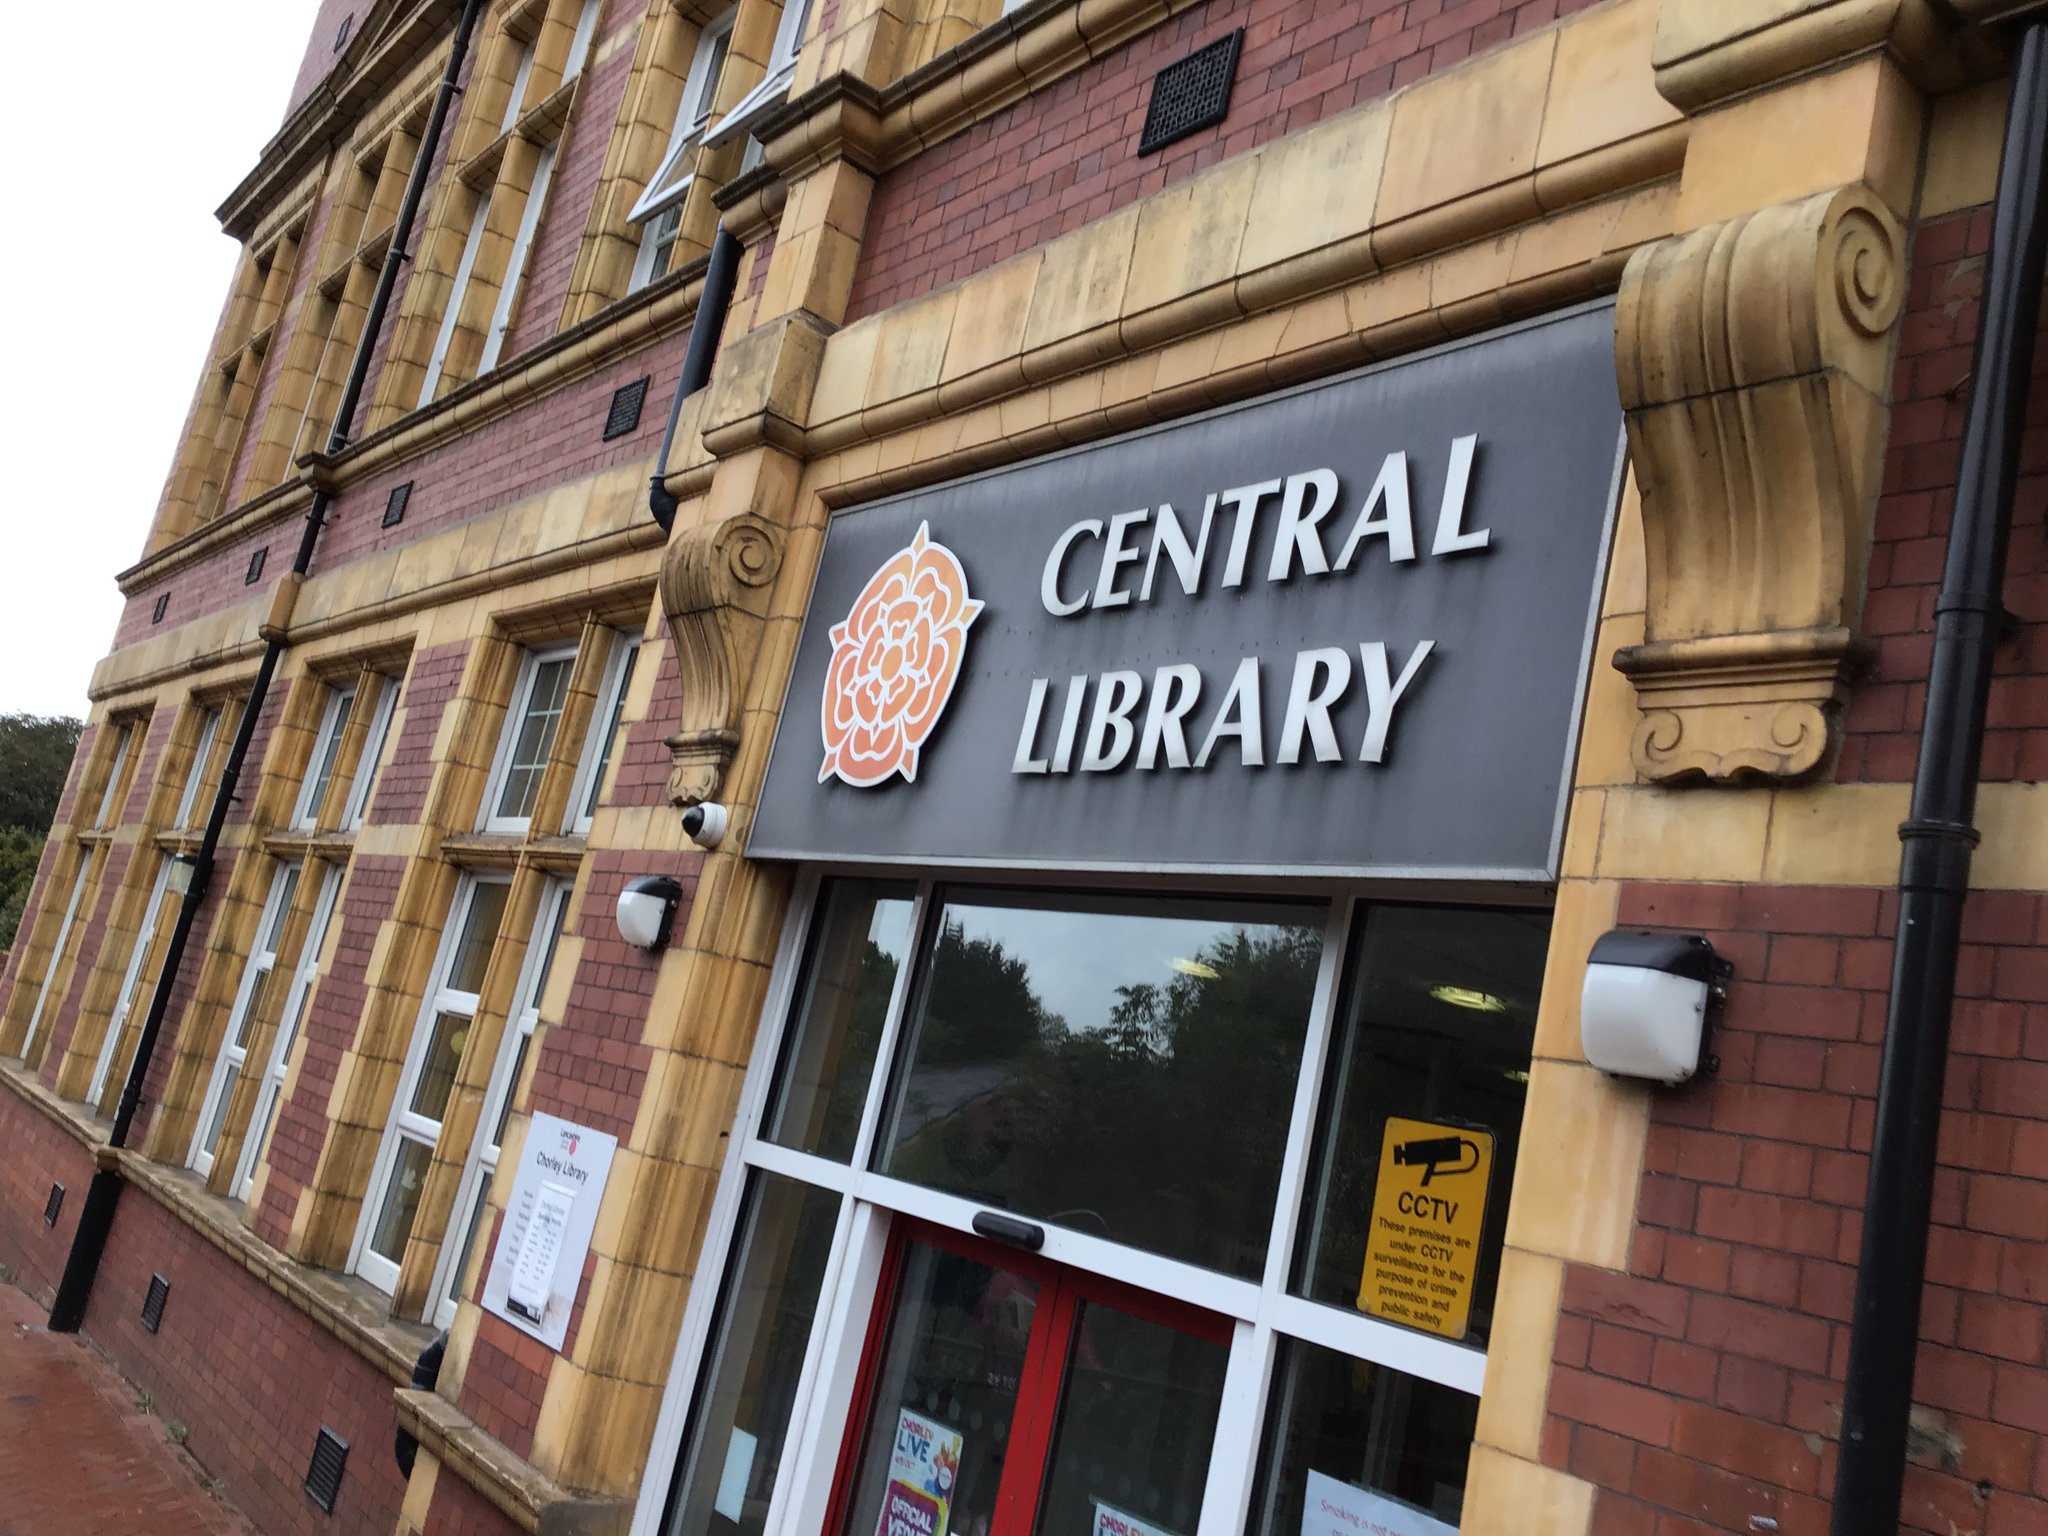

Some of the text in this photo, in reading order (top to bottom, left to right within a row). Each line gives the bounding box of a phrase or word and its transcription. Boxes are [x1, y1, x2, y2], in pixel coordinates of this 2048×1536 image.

[1040, 433, 1491, 616] CENTRAL
[1010, 639, 1437, 774] LIBRARY
[536, 1151, 589, 1186] Chorley Library
[1398, 1191, 1458, 1224] CCTV
[1379, 1216, 1471, 1248] These premises are
[1389, 1239, 1453, 1262] under CCTV
[1373, 1252, 1465, 1283] surveillance for the
[1376, 1268, 1456, 1297] purpose of crime
[1378, 1285, 1449, 1312] prevention and
[1380, 1300, 1441, 1328] public safety
[897, 1427, 931, 1463] LIVE
[891, 1495, 932, 1534] OFFICIAL
[1320, 1499, 1360, 1528] Smoking
